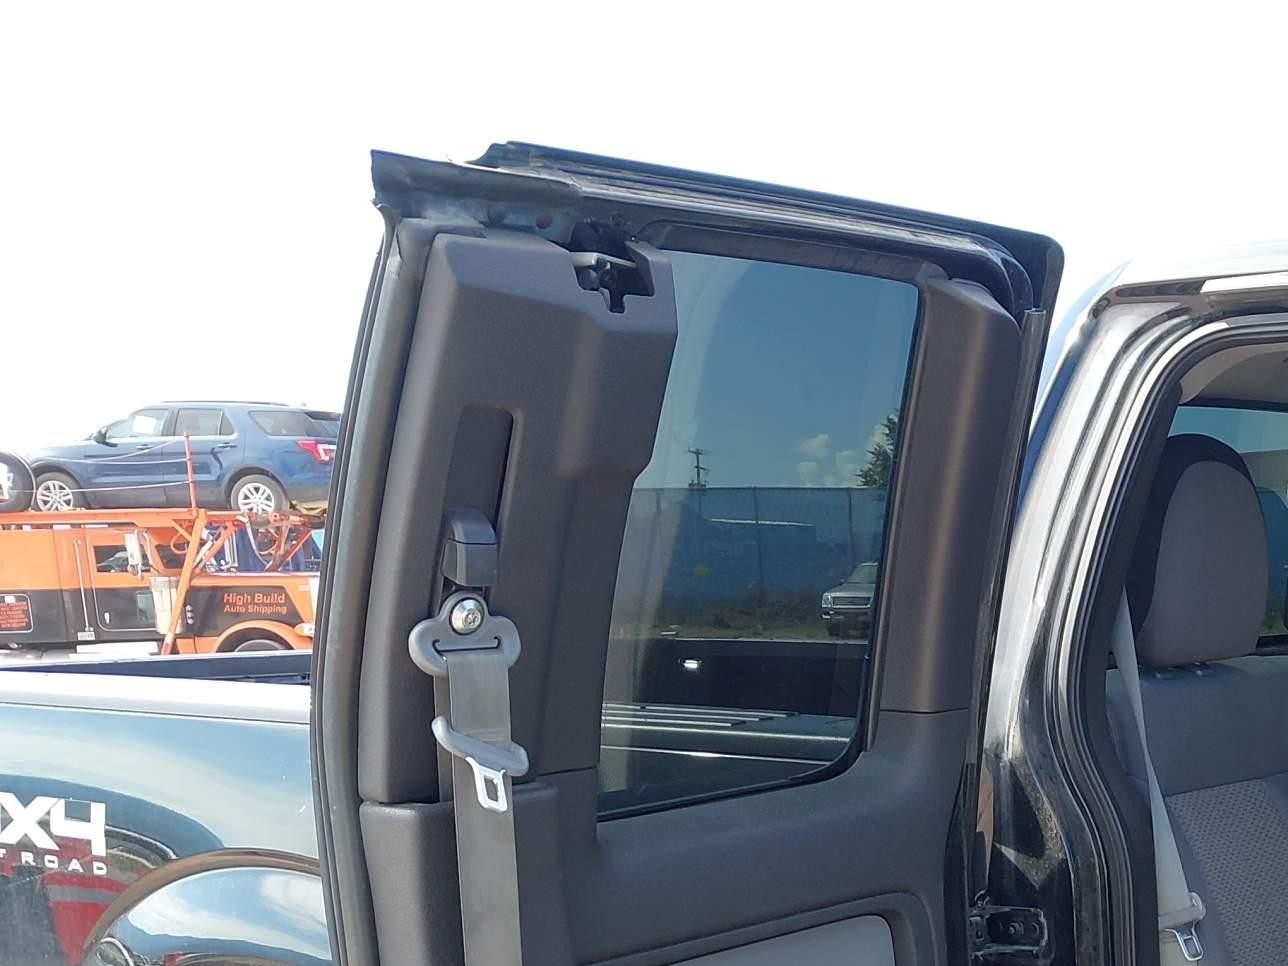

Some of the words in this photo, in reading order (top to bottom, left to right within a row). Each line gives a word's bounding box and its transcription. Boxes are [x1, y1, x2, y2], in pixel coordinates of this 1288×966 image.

[224, 592, 251, 605] High
[255, 592, 285, 604] Build
[224, 605, 245, 613] Auto
[248, 605, 287, 615] Shipping
[0, 791, 106, 857] X4
[21, 851, 107, 875] ROAD
